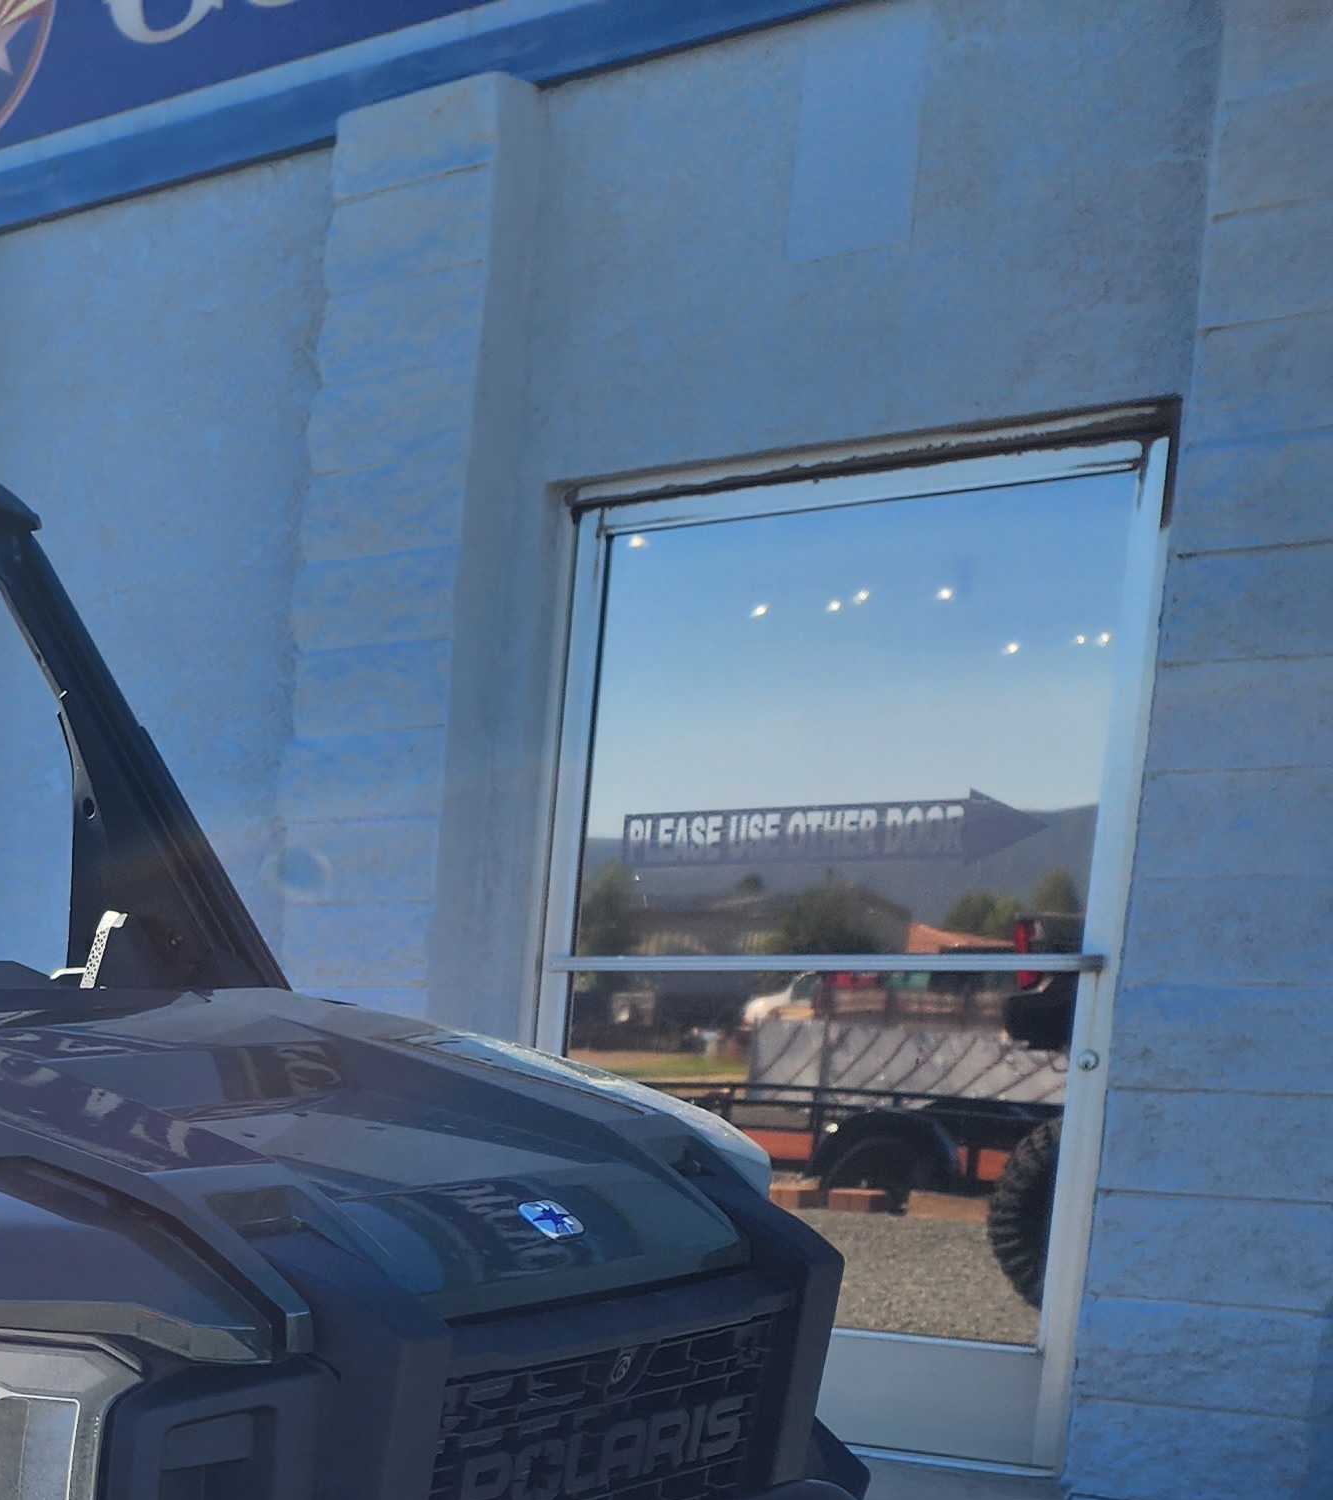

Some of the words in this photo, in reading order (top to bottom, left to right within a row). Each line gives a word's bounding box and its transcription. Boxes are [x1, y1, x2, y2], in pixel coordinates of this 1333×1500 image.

[629, 814, 723, 861] PLEASE
[728, 812, 781, 860] USE
[787, 808, 877, 858] OTHER
[885, 805, 964, 855] DOOR
